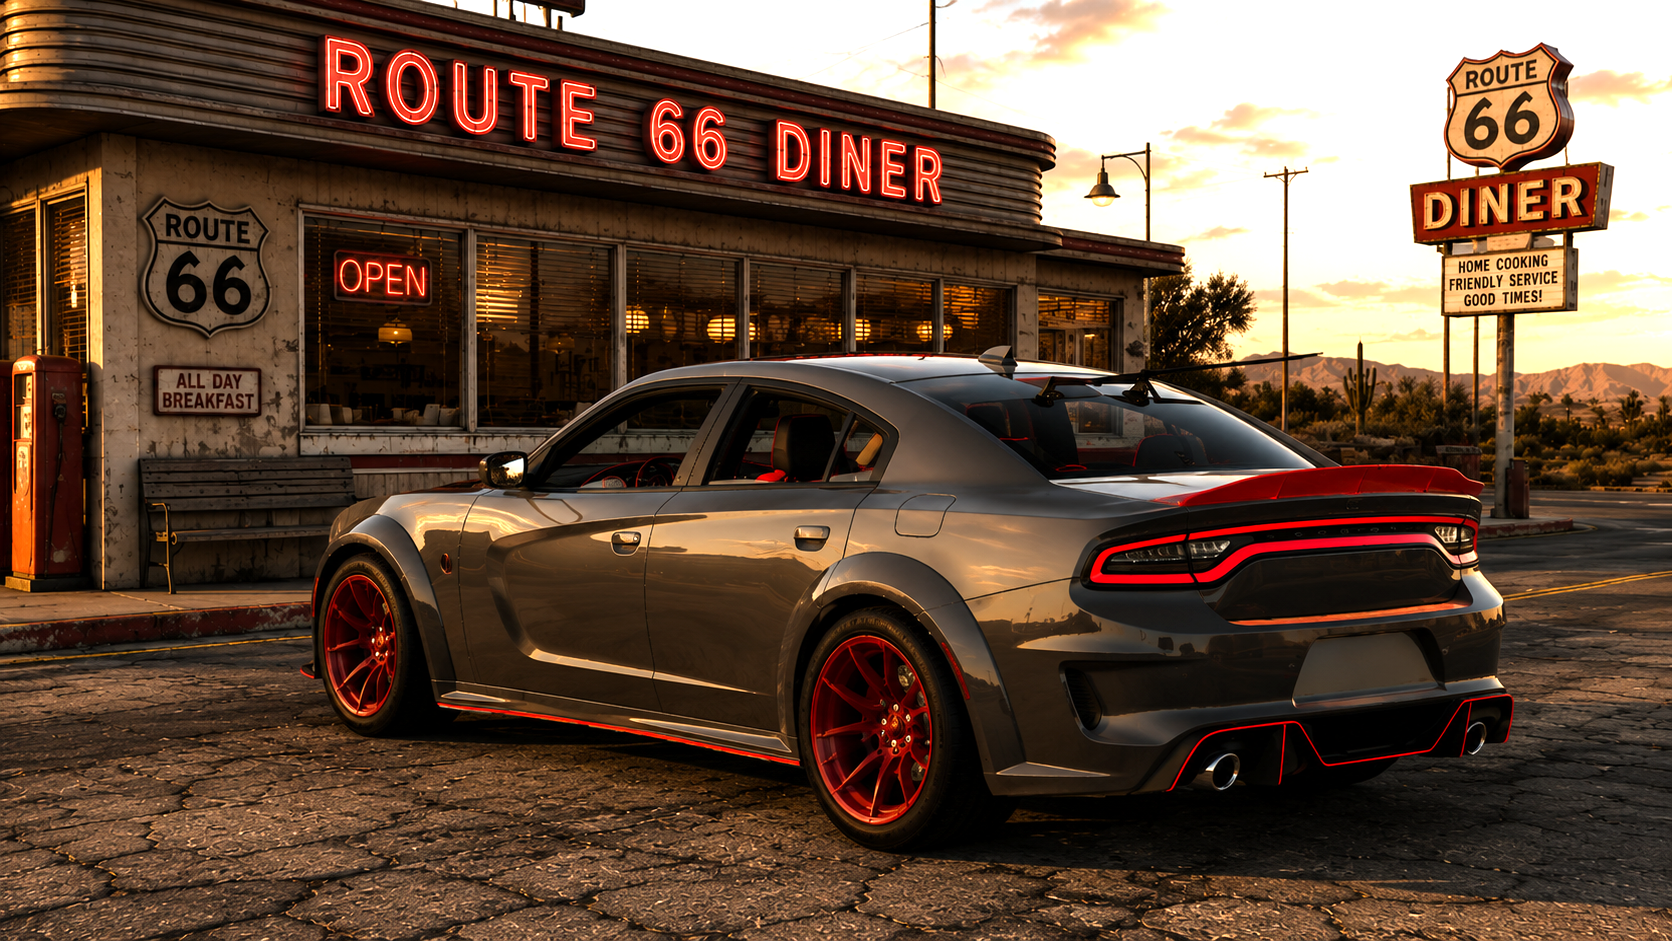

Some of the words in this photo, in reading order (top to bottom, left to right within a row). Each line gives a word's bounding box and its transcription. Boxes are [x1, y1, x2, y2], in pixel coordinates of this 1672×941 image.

[1465, 59, 1538, 90] ROUTE
[319, 34, 598, 153] ROUTE
[645, 98, 728, 171] 66
[770, 119, 943, 206] DINER
[1464, 90, 1540, 151] 66
[1423, 176, 1583, 231] DINER
[165, 213, 251, 245] ROUTE
[339, 258, 426, 298] OPEN
[1458, 258, 1490, 274] HOME
[1496, 254, 1549, 271] COOKING
[166, 250, 252, 316] 66
[1449, 274, 1504, 291] FRIENDLY
[1509, 271, 1558, 288] SERVICE
[1464, 292, 1496, 307] GOOD
[1502, 290, 1543, 304] TIMES!
[176, 372, 206, 389] ALL
[212, 373, 243, 390] DAY
[162, 391, 255, 410] BREAKFAST
